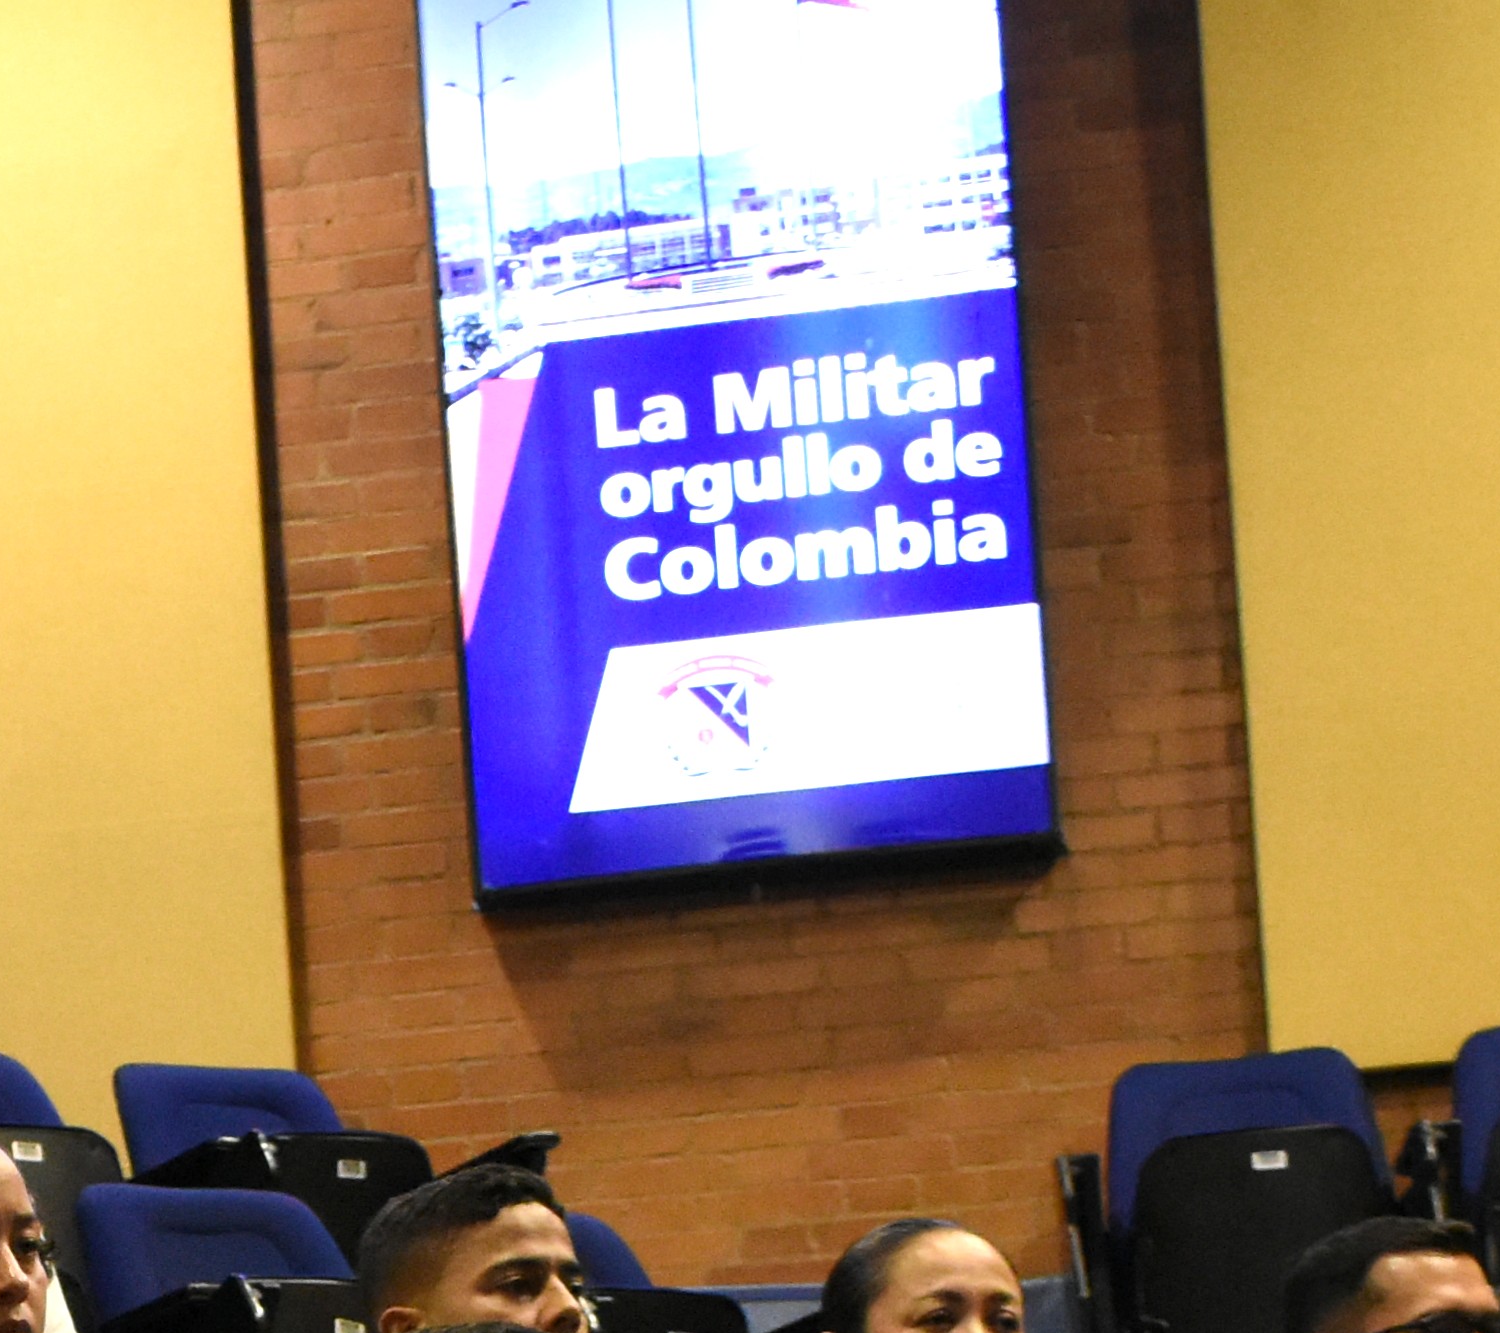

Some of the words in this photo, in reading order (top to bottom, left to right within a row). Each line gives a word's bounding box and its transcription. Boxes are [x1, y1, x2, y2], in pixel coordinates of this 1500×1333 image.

[593, 386, 687, 449] La
[712, 351, 996, 435] Militar
[600, 431, 884, 525] orgullo
[903, 418, 1003, 484] de
[604, 498, 1008, 602] Colombia
